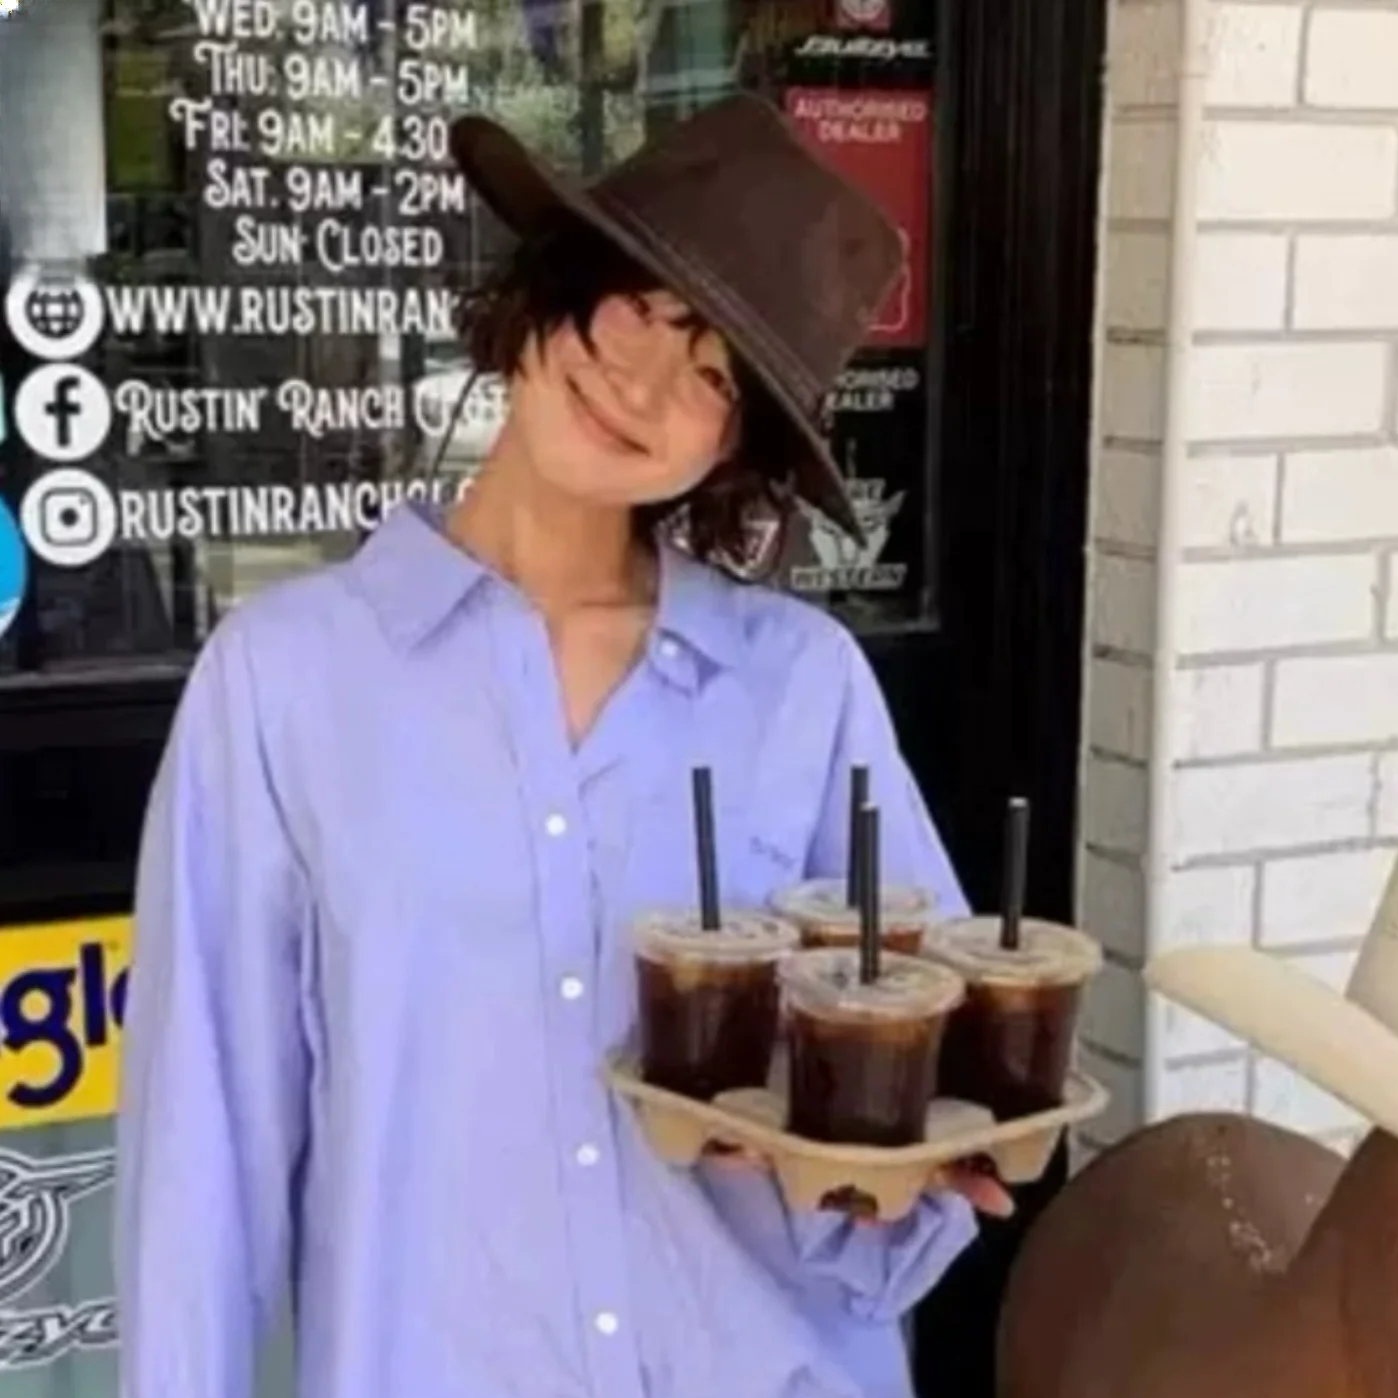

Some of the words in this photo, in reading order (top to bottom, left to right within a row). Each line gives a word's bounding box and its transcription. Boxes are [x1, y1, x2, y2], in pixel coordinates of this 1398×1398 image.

[292, 0, 368, 44] 9AM
[405, 4, 477, 50] 5PM
[284, 54, 361, 100] 9AM
[398, 60, 470, 105] 5PM
[257, 108, 336, 155] 9AM
[818, 120, 901, 142] DEALER
[285, 167, 363, 212] 9AM
[395, 169, 466, 215] 2PM
[316, 218, 444, 273] CLOSED
[106, 286, 461, 335] WWW.RUSTINRAN
[824, 391, 895, 412] EALER
[835, 367, 920, 391] ORISED
[276, 380, 404, 438] RANCH
